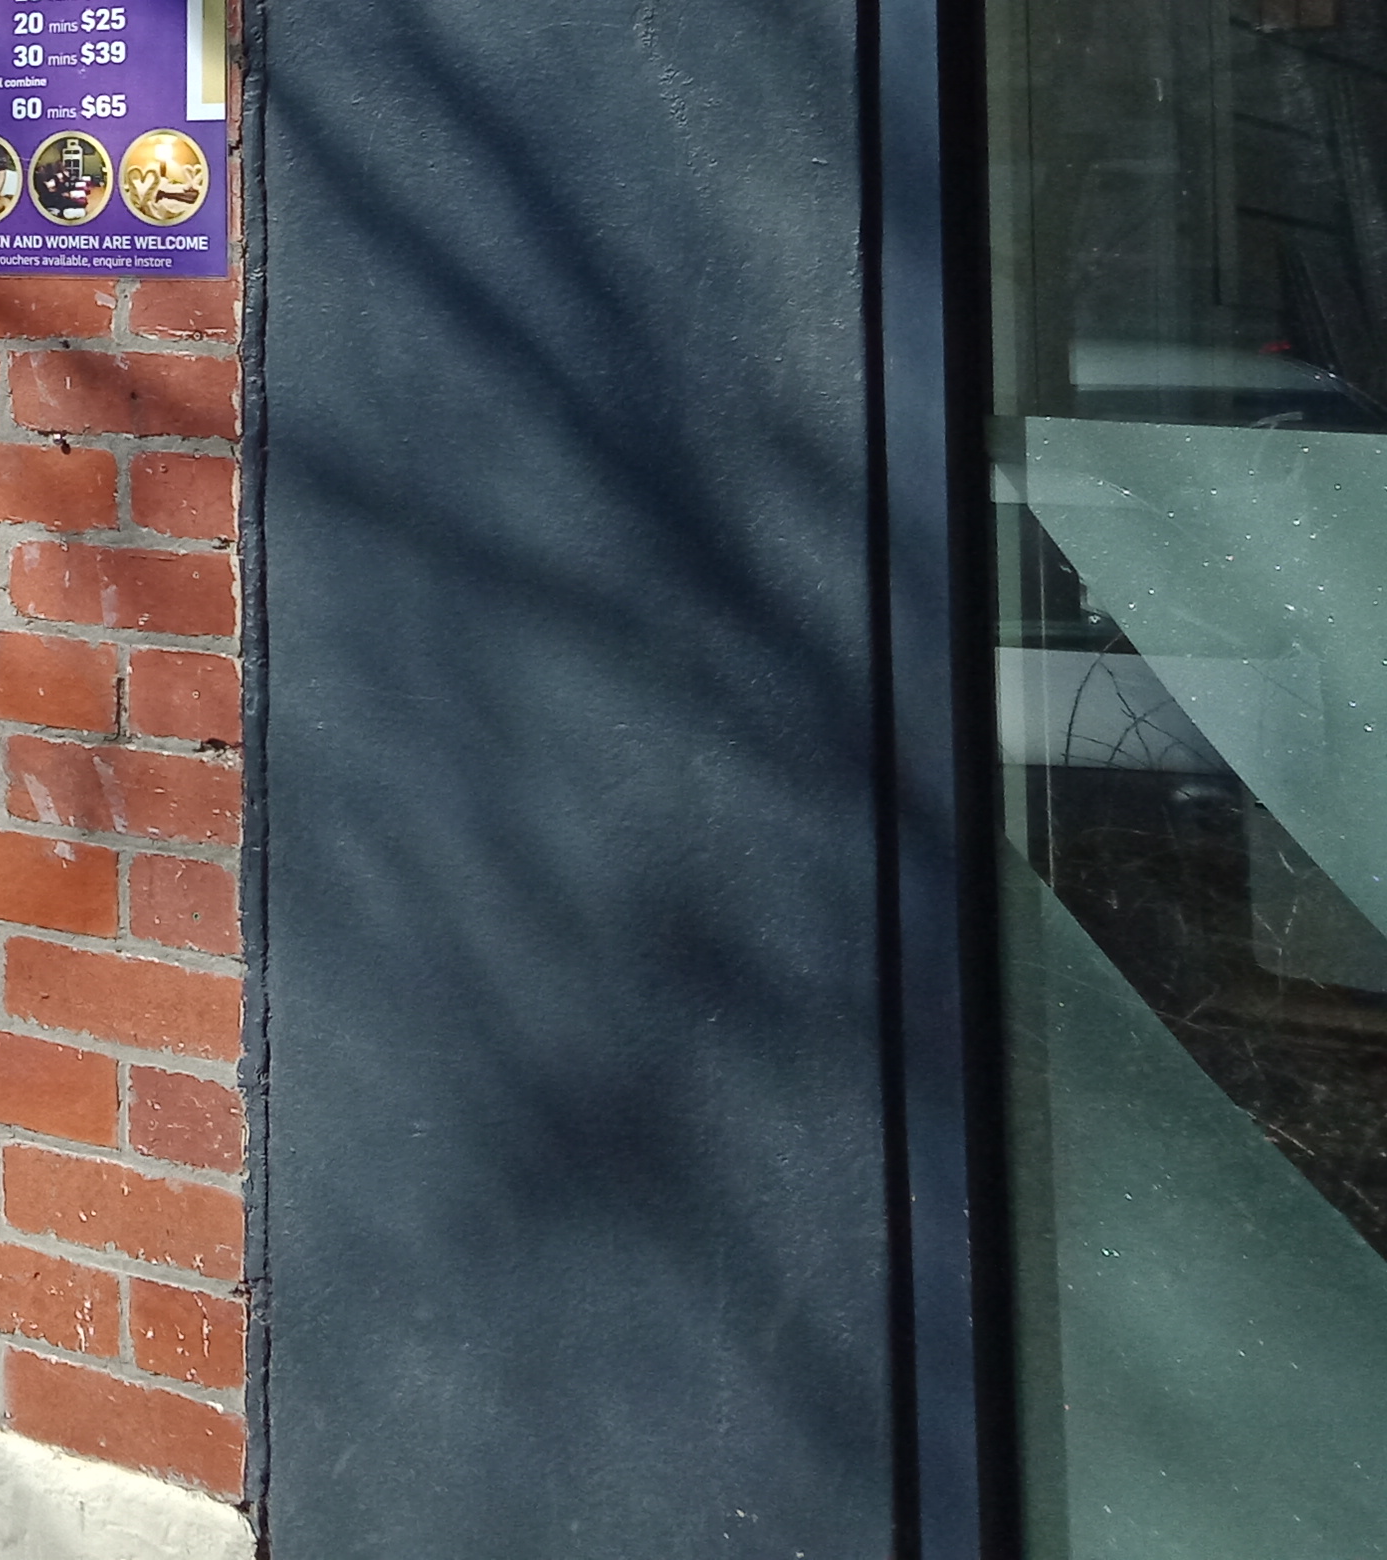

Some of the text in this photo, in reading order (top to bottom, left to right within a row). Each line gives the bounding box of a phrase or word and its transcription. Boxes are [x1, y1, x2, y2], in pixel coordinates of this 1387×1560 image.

[13, 7, 126, 35] 20 mins $25
[13, 40, 126, 68] 30 mins $39
[4, 76, 47, 88] combine
[11, 94, 127, 120] 60 mins $65
[13, 235, 42, 249] AND
[44, 235, 100, 250] WOMEN
[102, 236, 131, 250] ARE
[134, 236, 209, 251] WELCOME
[42, 254, 91, 268] available,
[93, 255, 132, 268] enquire
[134, 255, 172, 268] instore
